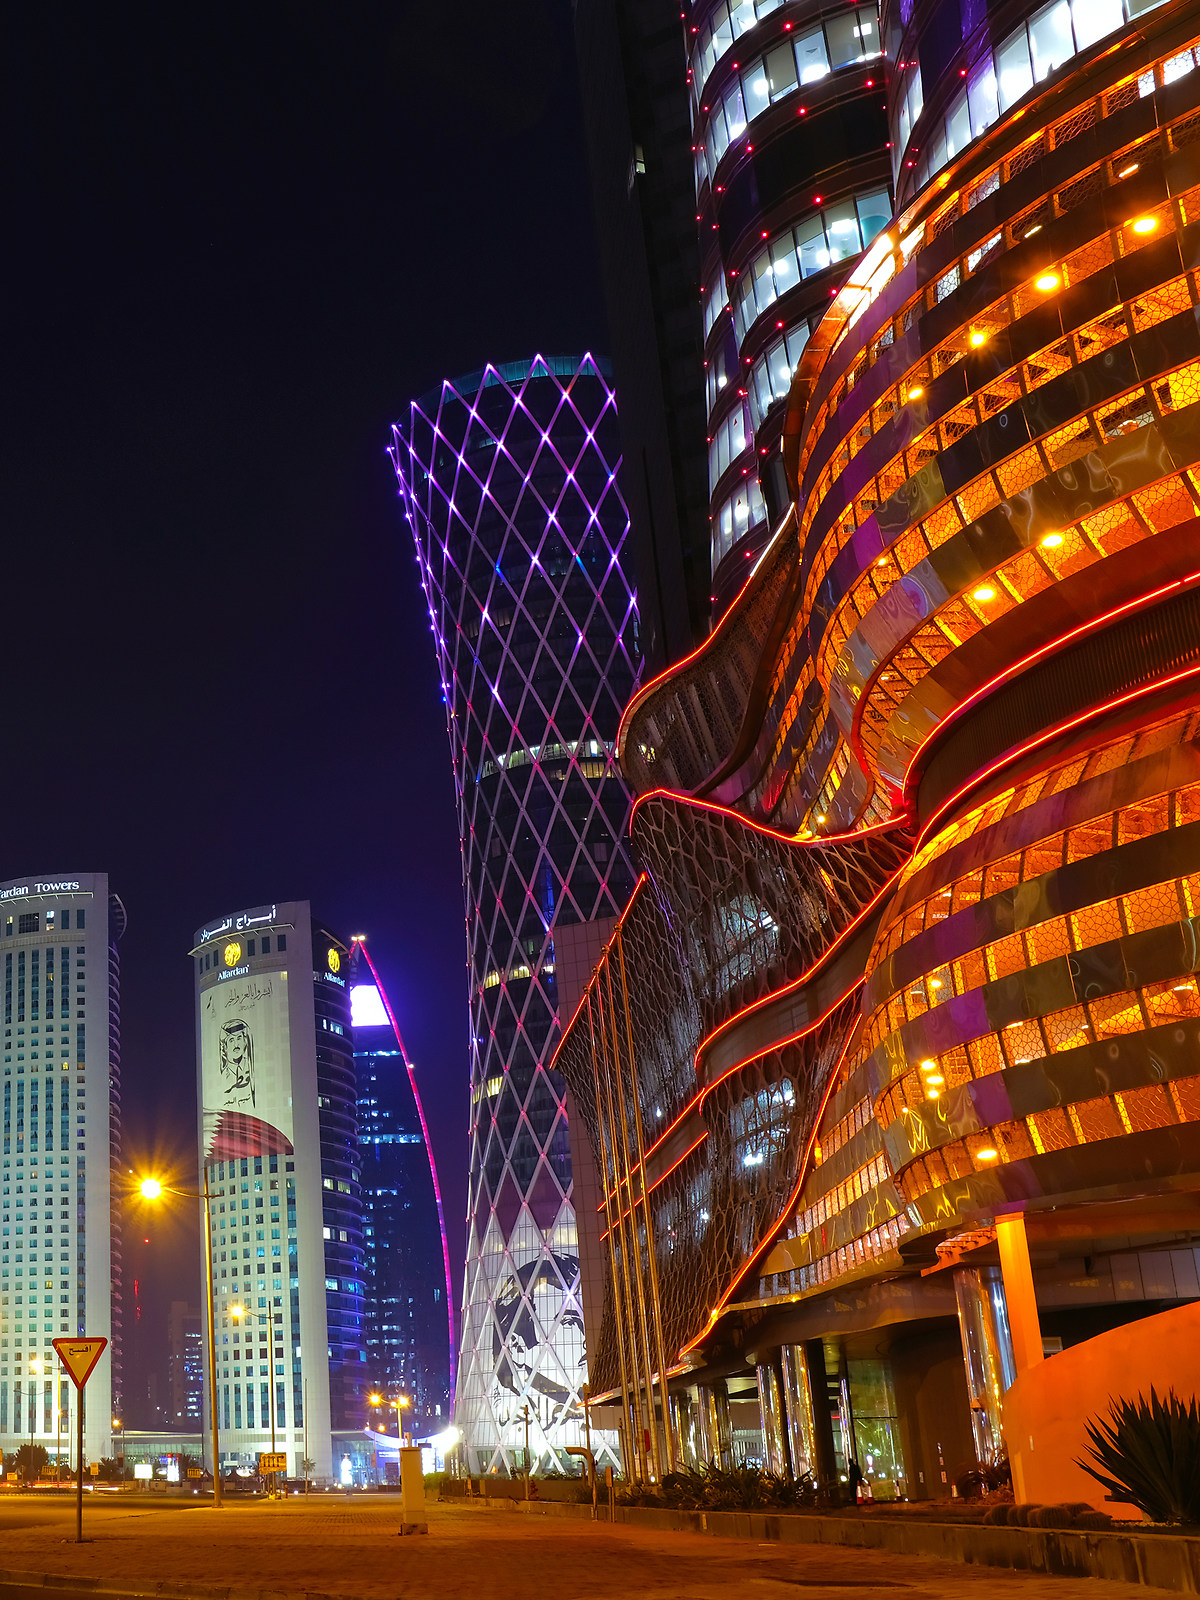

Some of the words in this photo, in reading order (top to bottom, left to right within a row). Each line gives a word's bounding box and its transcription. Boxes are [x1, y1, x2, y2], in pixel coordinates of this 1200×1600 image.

[34, 881, 80, 893] Towers
[236, 904, 276, 930] أبراج
[217, 965, 249, 981] Alfardan
[69, 1344, 91, 1355] افسح
